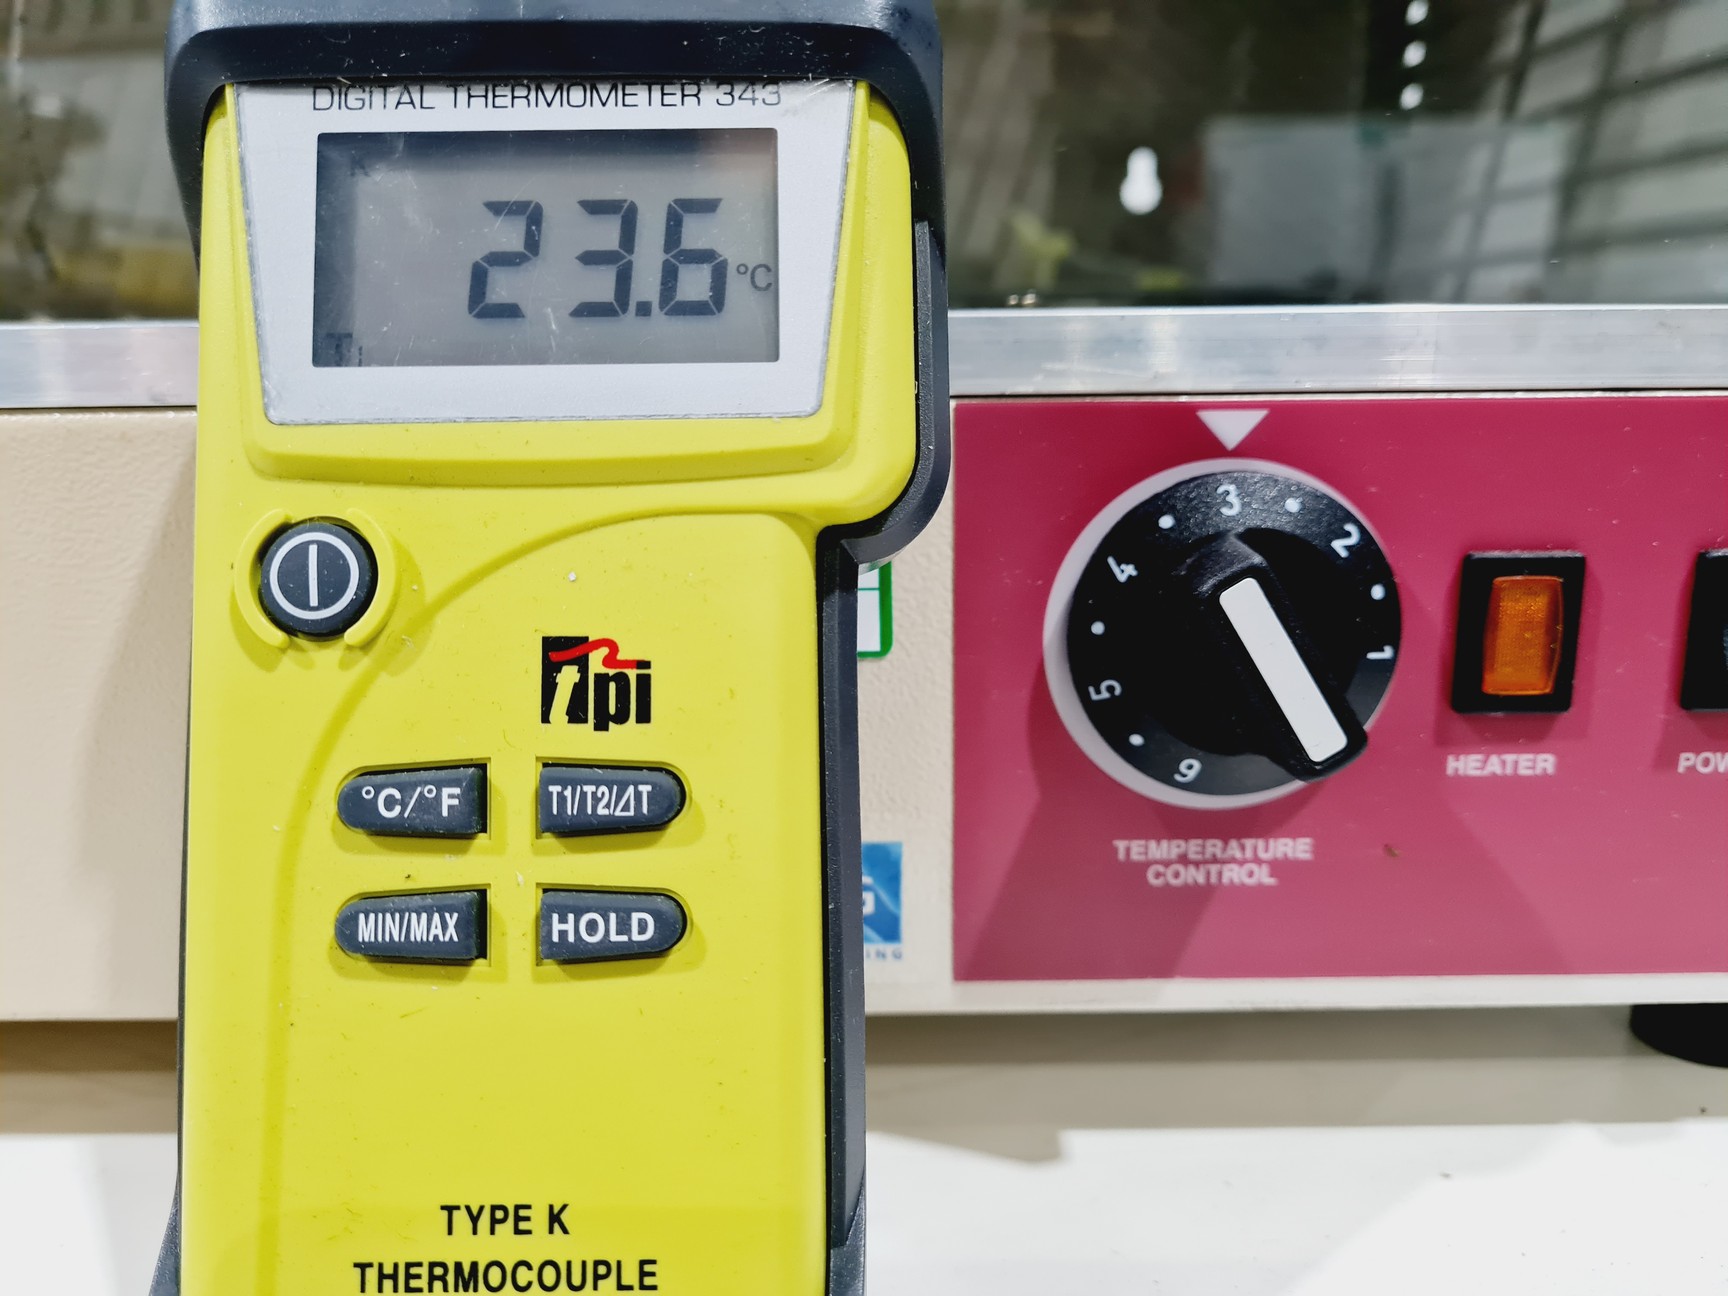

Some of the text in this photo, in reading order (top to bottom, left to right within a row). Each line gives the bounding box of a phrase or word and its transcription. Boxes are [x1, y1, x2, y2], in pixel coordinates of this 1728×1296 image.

[312, 81, 782, 111] DIGITAL THERMOMETER 343
[468, 198, 728, 319] 23.6
[1216, 484, 1242, 517] 3
[1330, 523, 1361, 558] 2
[1106, 556, 1138, 583] 4
[1366, 645, 1395, 661] 1
[541, 636, 651, 731] tpi
[1088, 679, 1122, 700] 5
[1445, 753, 1556, 777] HEATER
[361, 785, 461, 819] °C/°F
[1113, 837, 1315, 862] TEMPERATURE
[1145, 862, 1278, 887] CONTROL
[357, 912, 459, 943] MIN/MAX
[550, 911, 656, 943] HOLD
[440, 1203, 570, 1236] TYPE K
[352, 1258, 659, 1294] THERMOCOUPLE
